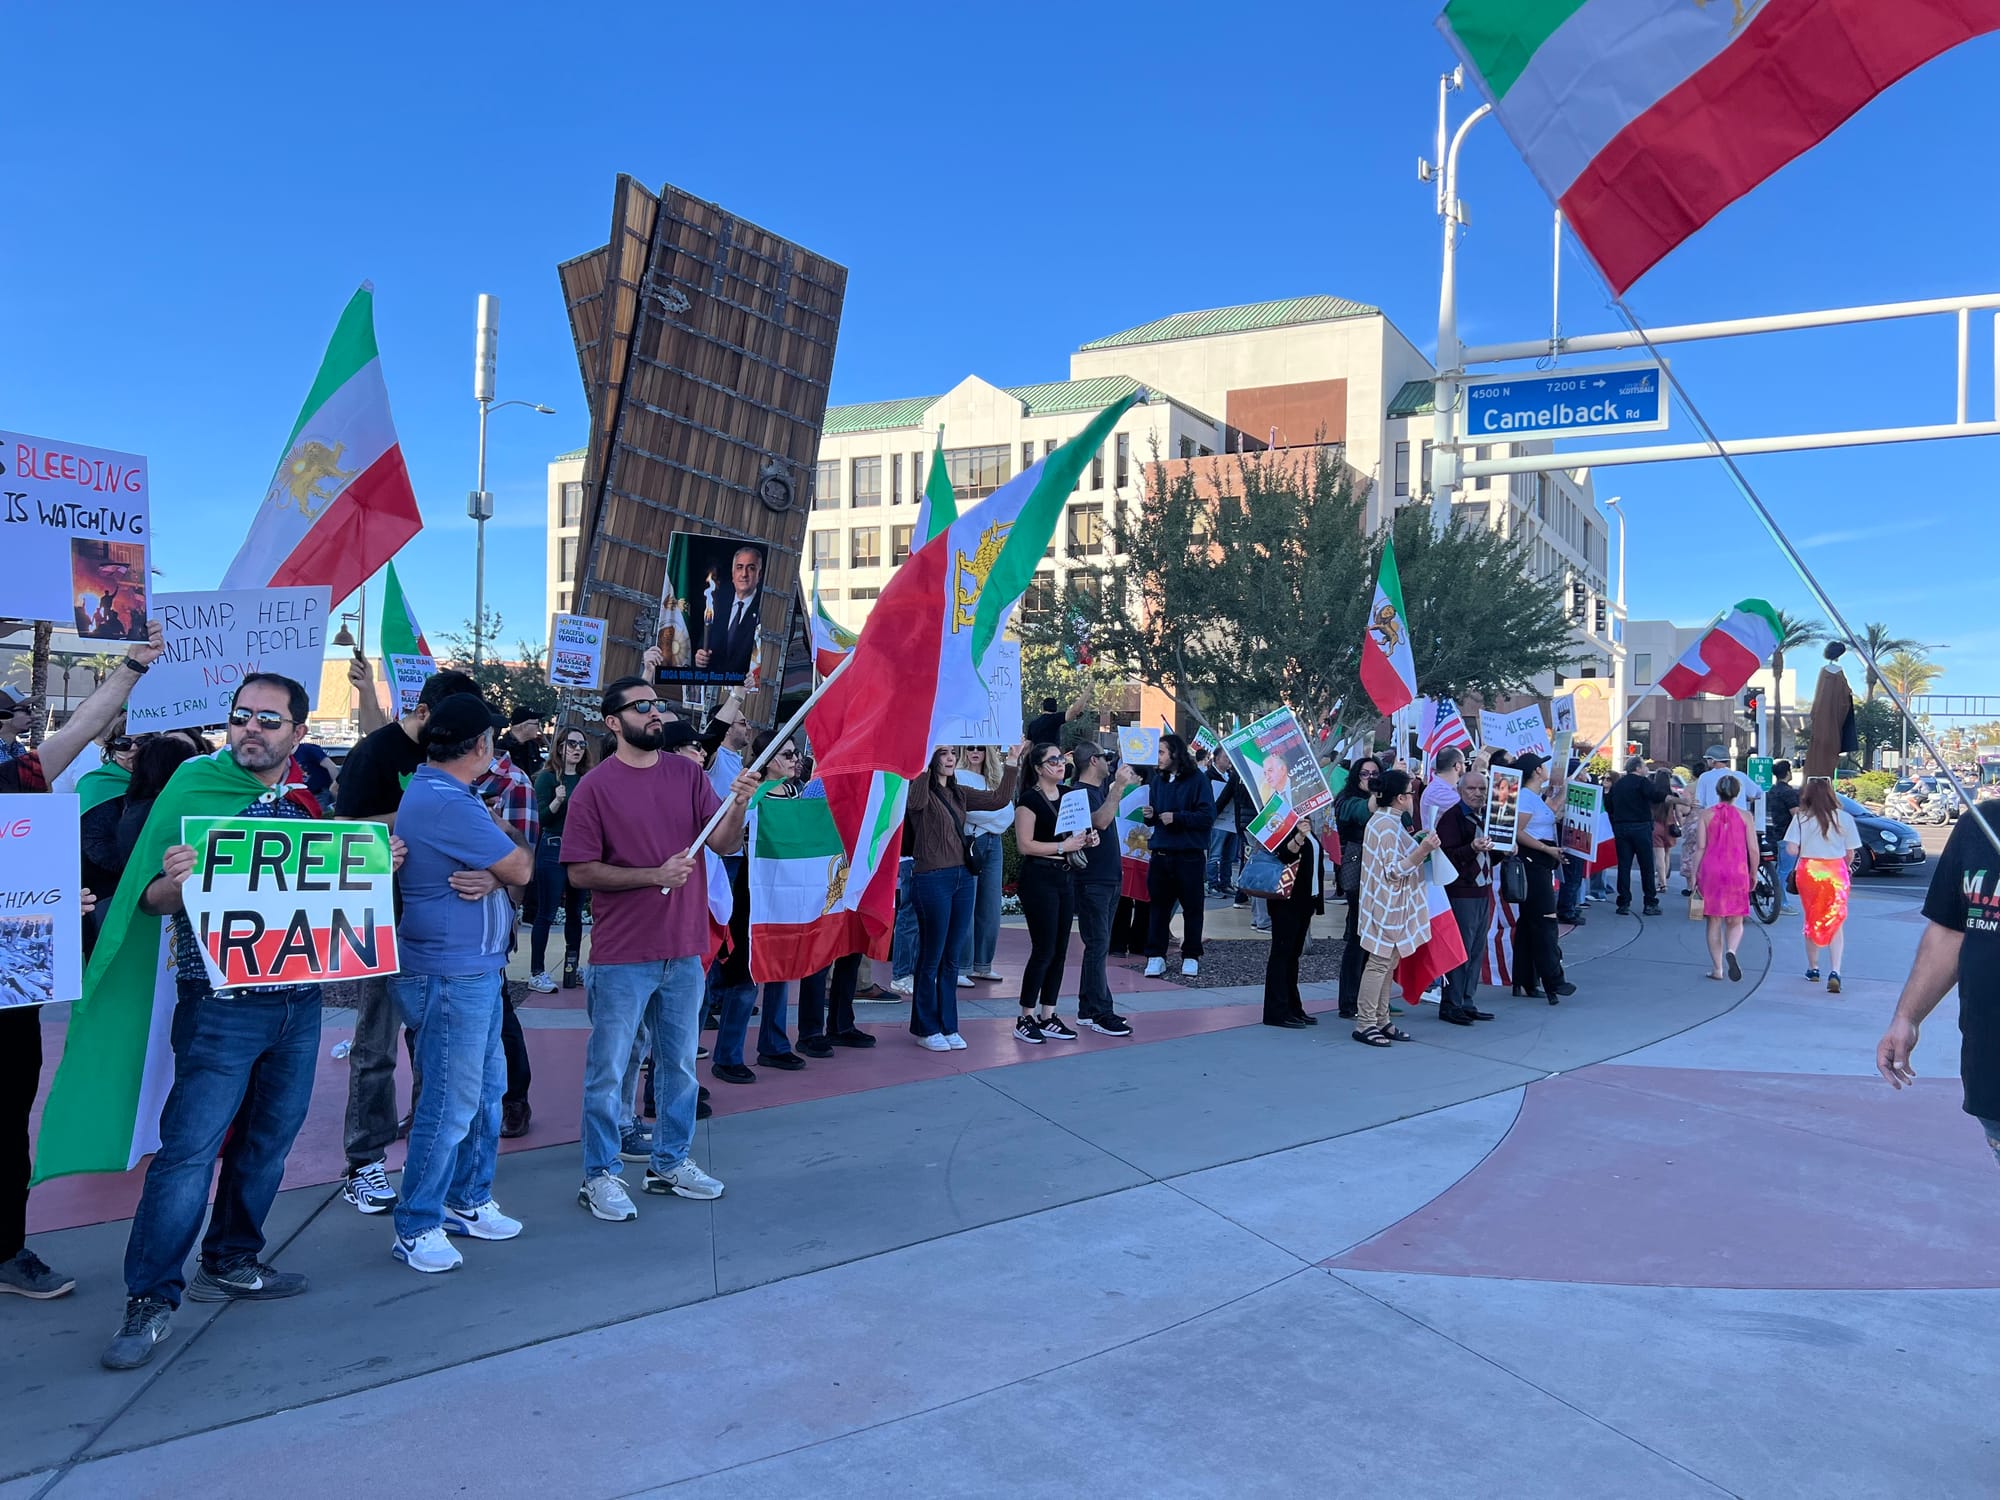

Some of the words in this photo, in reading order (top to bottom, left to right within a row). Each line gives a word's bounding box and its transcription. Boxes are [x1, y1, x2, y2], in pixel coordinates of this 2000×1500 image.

[1471, 388, 1500, 399] 4500
[1502, 387, 1511, 396] N
[1546, 381, 1576, 393] 7200
[1579, 380, 1587, 390] E
[1483, 400, 1619, 431] Camelback
[1625, 409, 1640, 419] Rd
[16, 444, 141, 493] BLEEDING
[3, 492, 29, 523] IS
[37, 499, 144, 535] WATCHING
[258, 598, 318, 624] HELP
[246, 626, 320, 657] PEOPLE
[558, 634, 585, 645] WORLD
[556, 657, 592, 668] MASSACRE
[399, 675, 423, 683] WORLD
[131, 707, 168, 721] MAKE
[172, 697, 208, 716] IRAN
[1505, 718, 1518, 737] All
[1517, 716, 1540, 731] Eyes
[1519, 731, 1534, 746] on
[1566, 788, 1593, 818] FREE
[1562, 817, 1591, 851] IRAN
[201, 830, 375, 893] FREE
[1975, 919, 1998, 931] IRAN
[200, 907, 380, 977] IRAN
